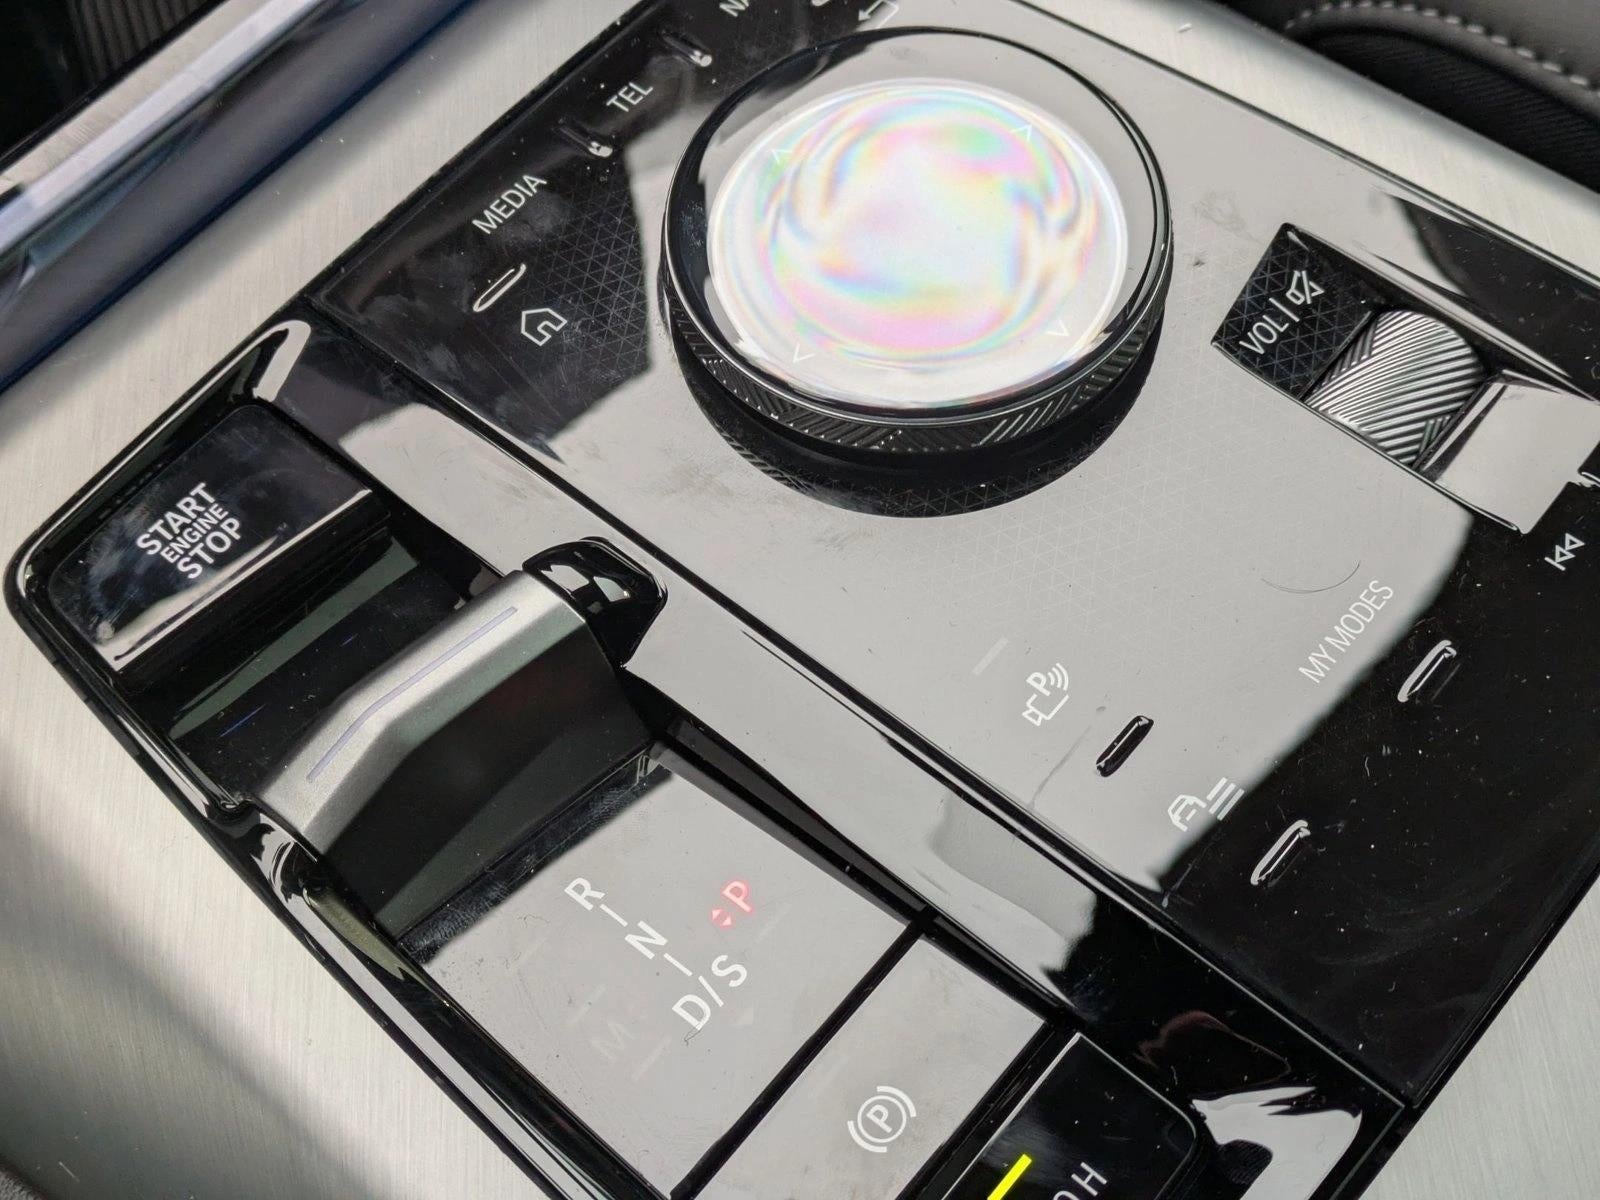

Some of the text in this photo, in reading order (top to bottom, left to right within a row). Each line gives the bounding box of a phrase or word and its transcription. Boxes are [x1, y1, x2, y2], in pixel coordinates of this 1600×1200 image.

[719, 0, 749, 17] N
[606, 82, 654, 112] TEL
[472, 174, 547, 234] MEDIA
[136, 482, 215, 555] START
[160, 503, 229, 563] ENGINE
[177, 517, 241, 579] STOP
[1298, 579, 1393, 683] MY MODES
[564, 877, 605, 911] R
[722, 880, 752, 913] P
[624, 920, 668, 960] N
